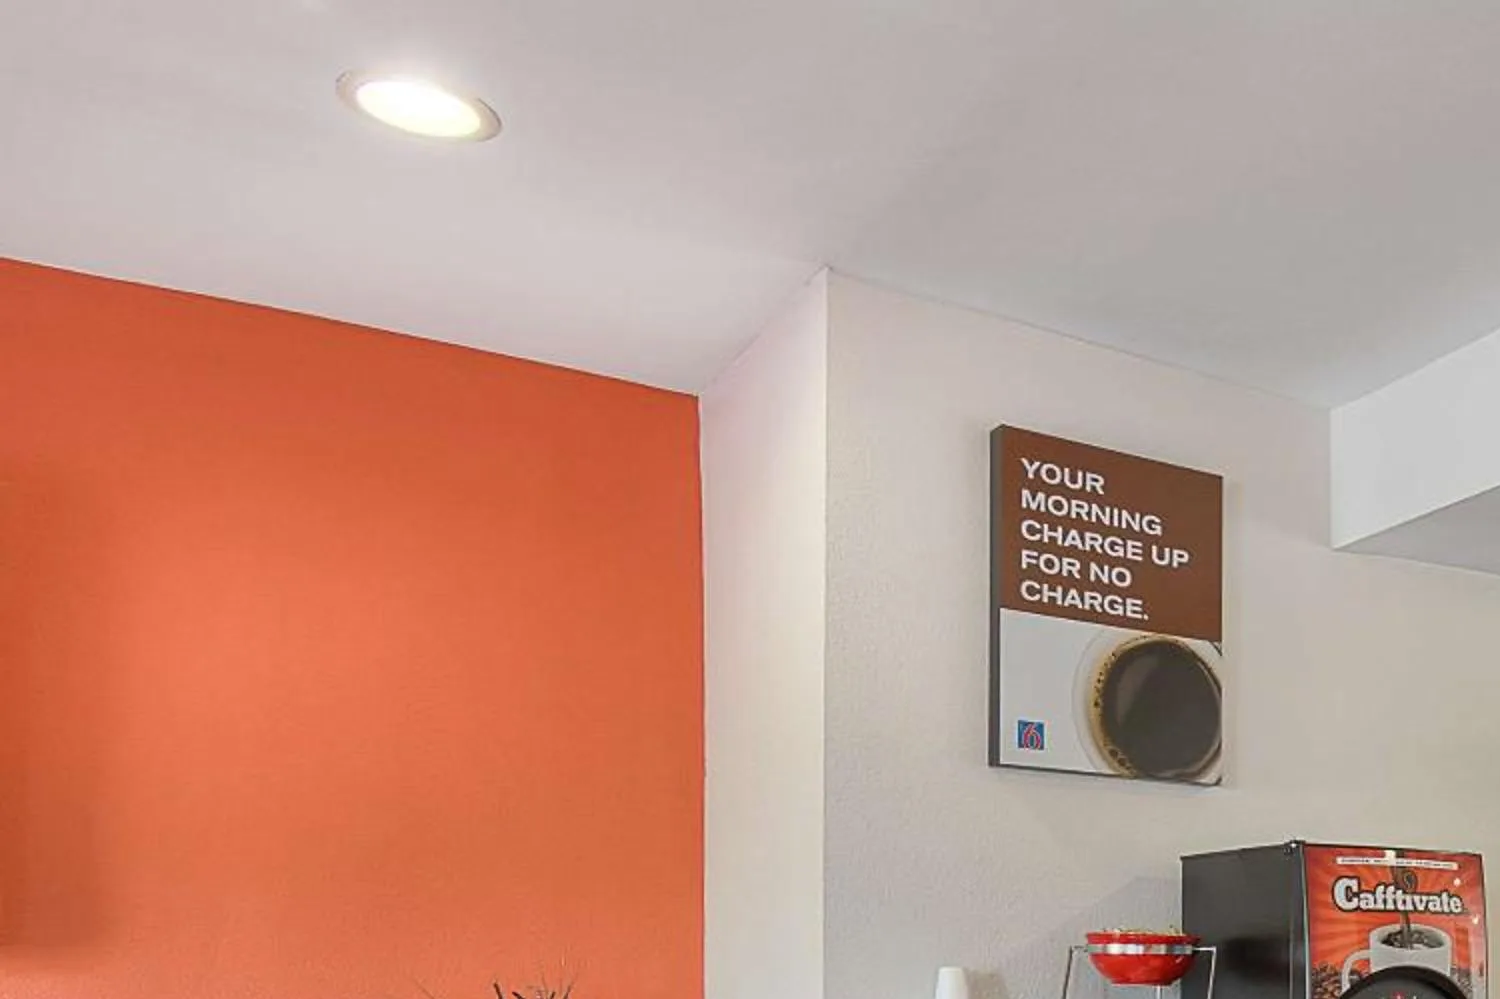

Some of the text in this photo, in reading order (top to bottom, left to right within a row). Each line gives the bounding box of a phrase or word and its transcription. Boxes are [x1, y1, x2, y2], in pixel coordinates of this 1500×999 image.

[1021, 457, 1105, 495] YOUR
[1021, 488, 1163, 536] MORNING
[1020, 519, 1190, 568] CHARGE UP
[1021, 548, 1132, 588] FOR NO
[1020, 579, 1149, 621] CHARGE.
[1333, 876, 1463, 914] Cafftivate
